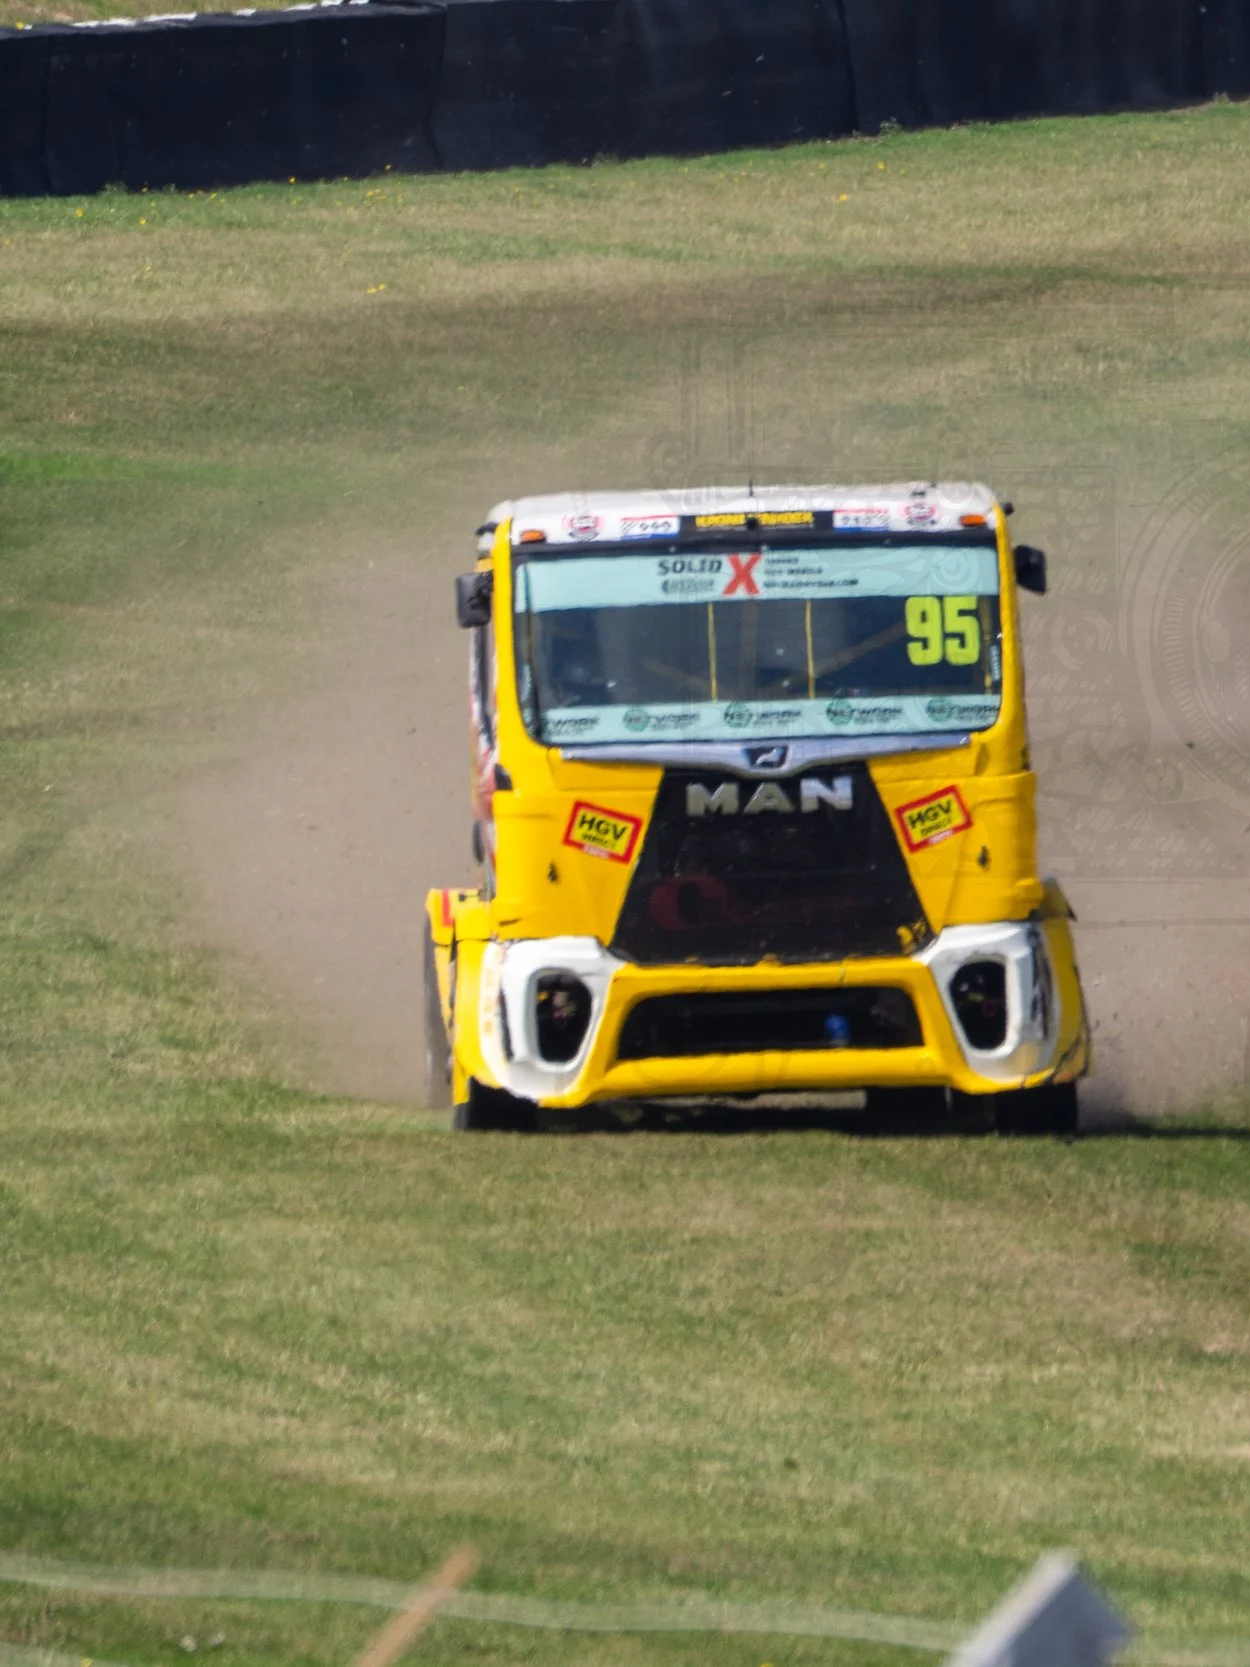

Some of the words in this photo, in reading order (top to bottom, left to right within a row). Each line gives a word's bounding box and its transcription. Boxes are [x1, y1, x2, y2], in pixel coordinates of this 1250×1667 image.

[657, 558, 723, 576] SOLID
[905, 595, 980, 667] 95
[685, 775, 855, 817] MAN
[577, 812, 628, 841] HGV
[908, 799, 952, 829] HGV
